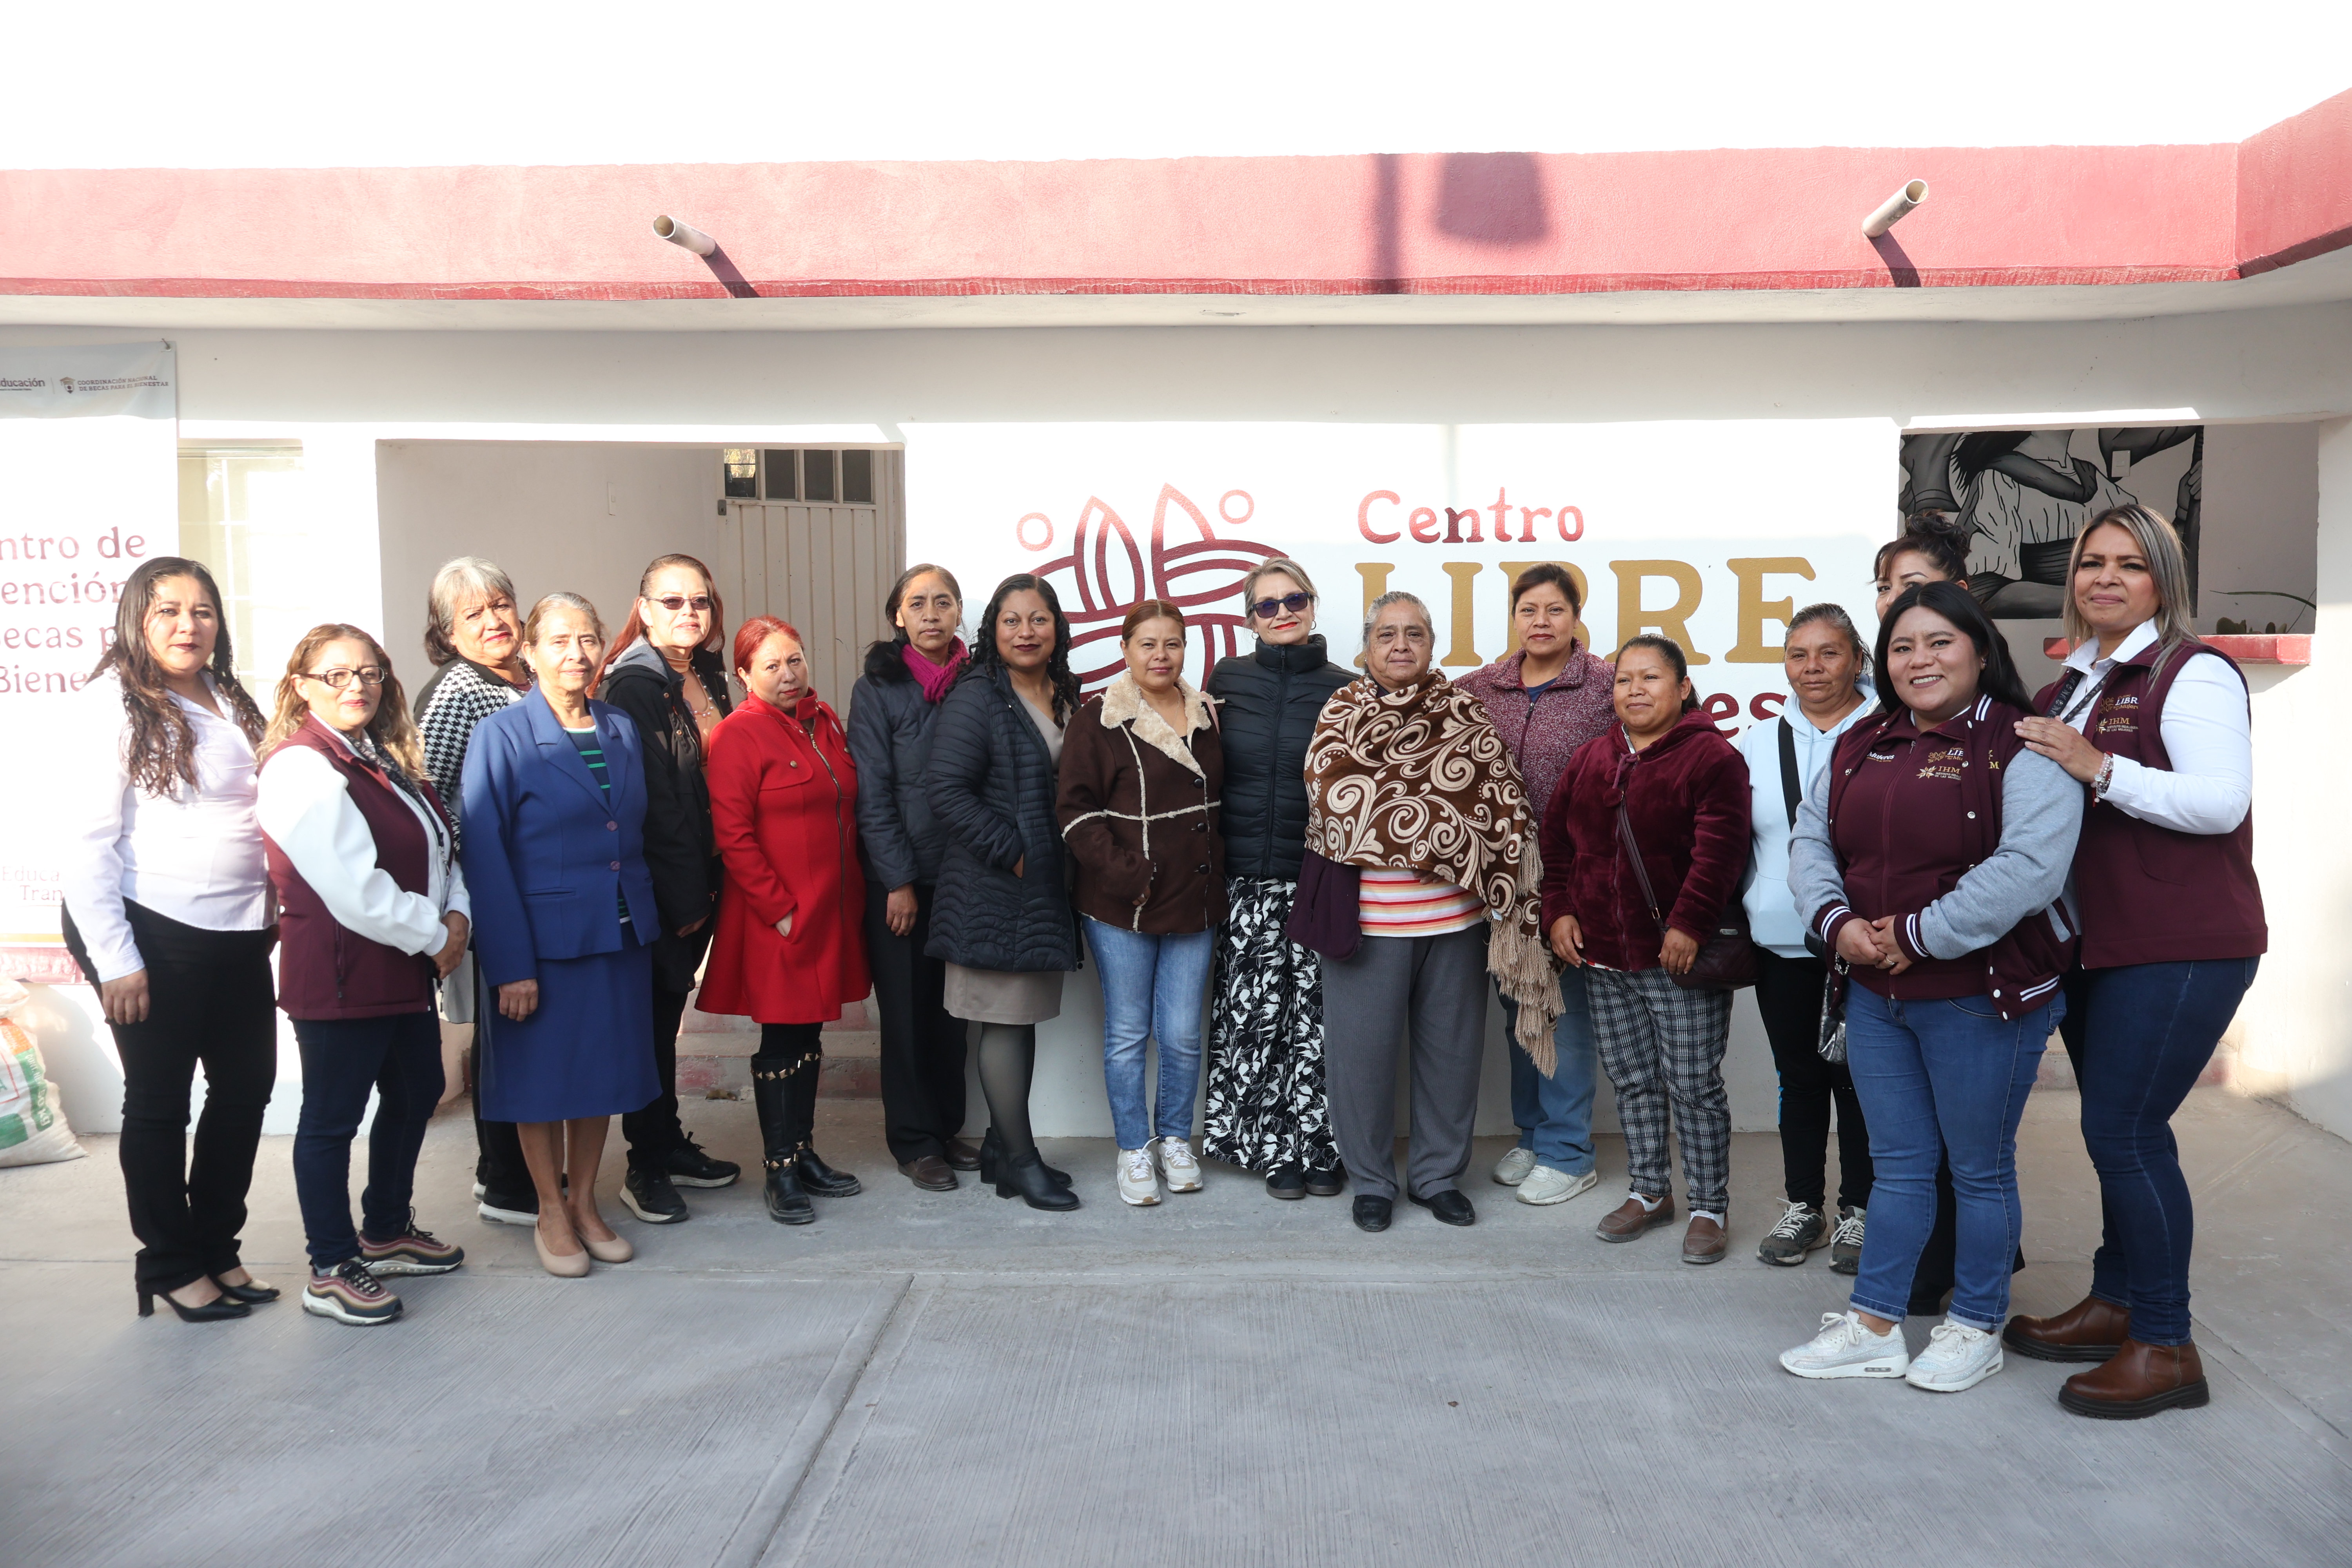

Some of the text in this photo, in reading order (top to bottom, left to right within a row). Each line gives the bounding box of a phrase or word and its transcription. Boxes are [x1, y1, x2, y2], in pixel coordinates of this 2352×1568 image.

[0, 378, 45, 387] ducación
[1357, 486, 1584, 544] Centro
[98, 526, 146, 558] de
[0, 627, 83, 649] ecas
[1867, 751, 1895, 760] Mujeres
[1938, 766, 1960, 774] IHM
[2, 866, 59, 881] Educa
[20, 885, 63, 901] Tran
